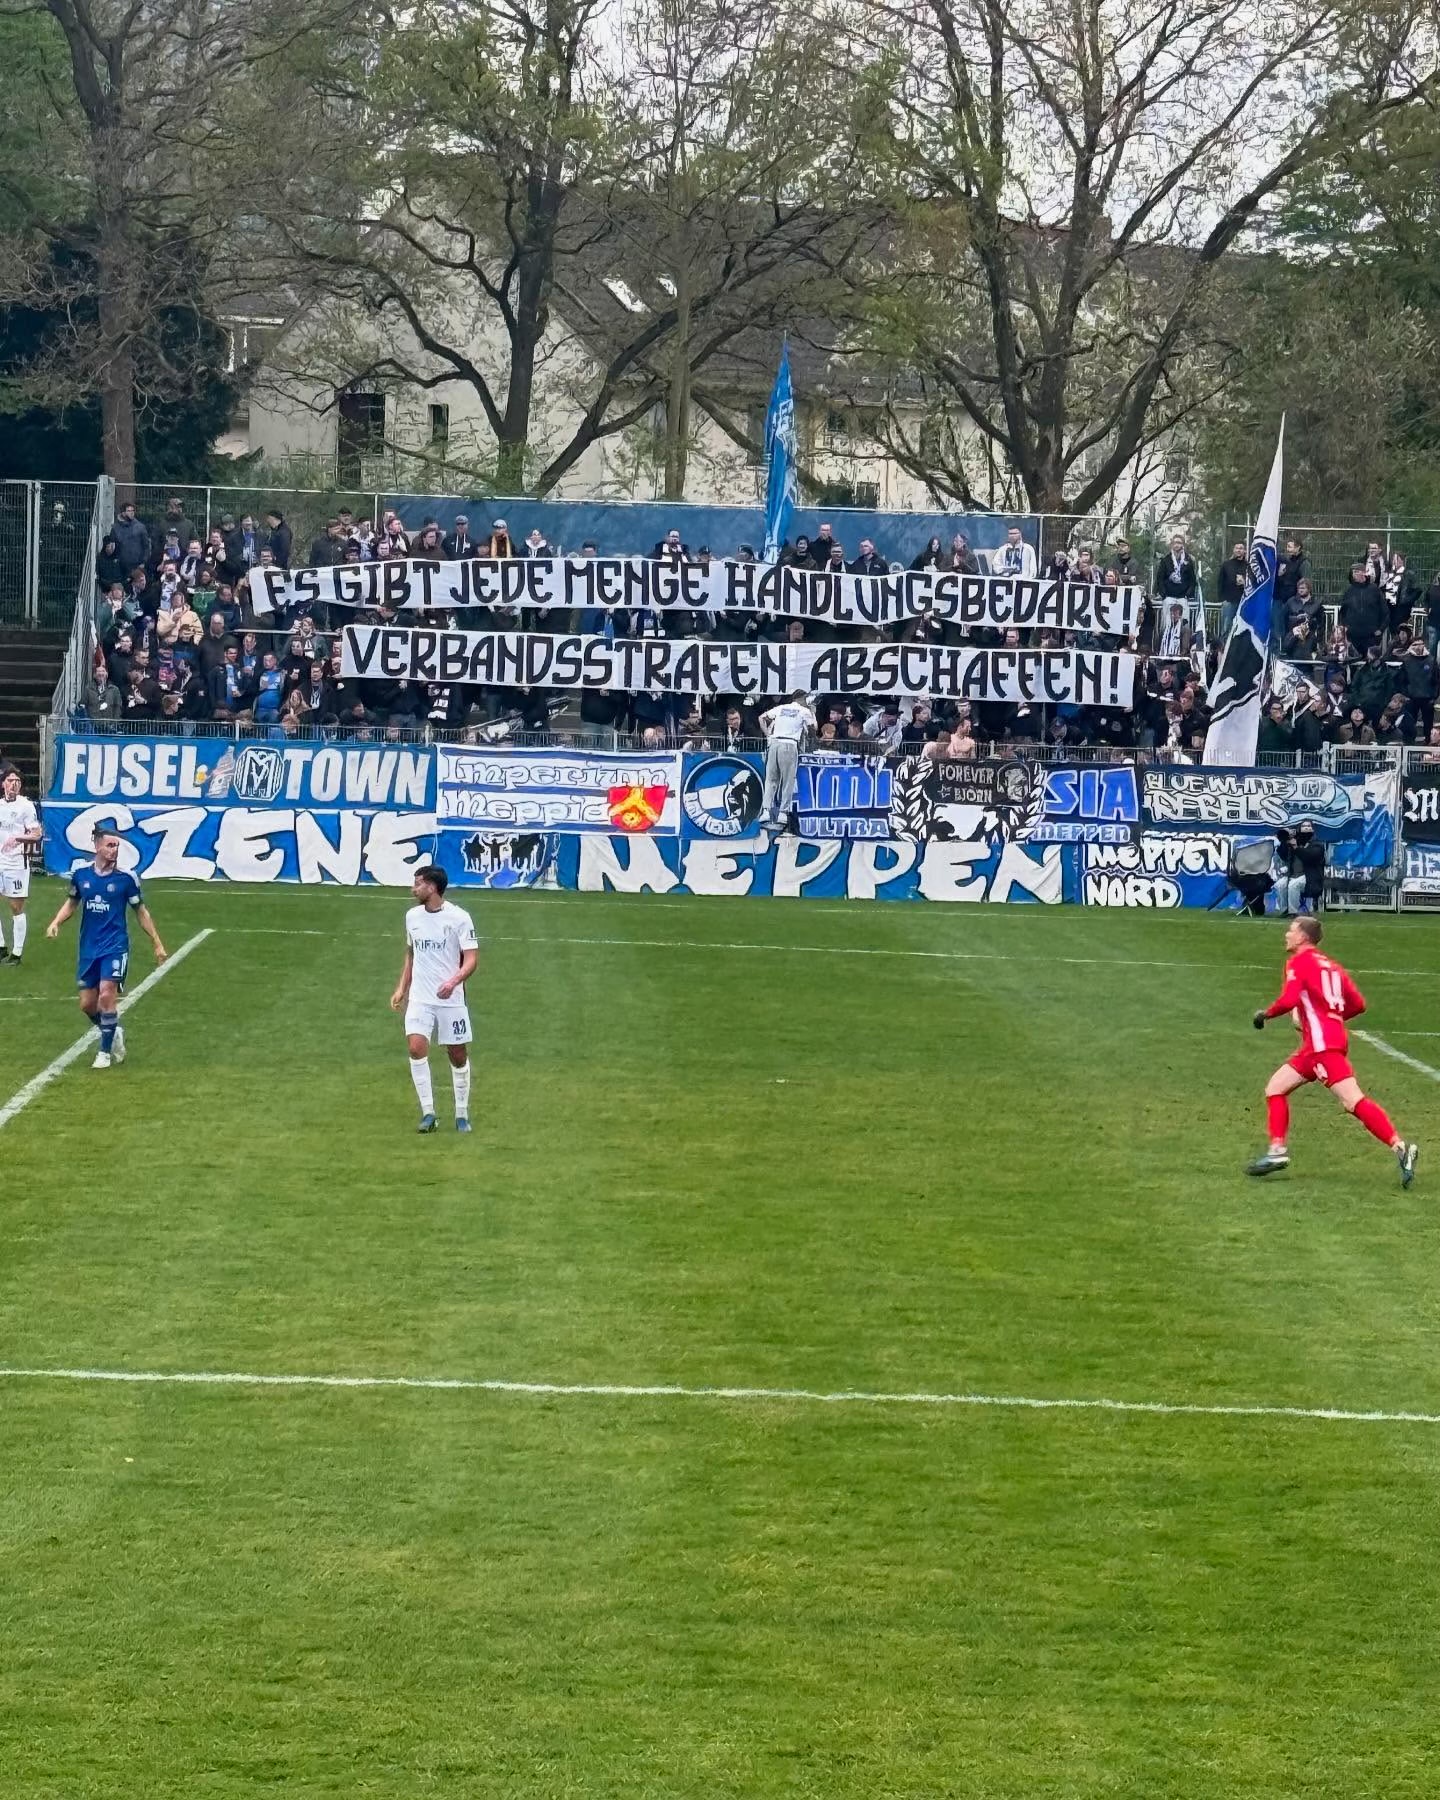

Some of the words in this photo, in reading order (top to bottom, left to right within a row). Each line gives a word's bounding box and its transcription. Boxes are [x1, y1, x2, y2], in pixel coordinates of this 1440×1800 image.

[264, 569, 320, 612] ES
[333, 561, 440, 607] GIBT
[450, 560, 553, 604] JEDE
[565, 560, 709, 606] MENGE
[725, 561, 1132, 634] HANDLUNGSBEDARF!
[346, 627, 787, 692] VERBANDSSTRAFEN
[810, 645, 1119, 704] ABSCHAFFEN!
[62, 742, 202, 798] FUSEL
[283, 748, 431, 806] TOWN
[938, 763, 995, 785] FOREVER
[1145, 772, 1204, 792] BLUE
[1207, 774, 1290, 795] WHITE
[953, 786, 993, 804] BJÖRN
[1149, 791, 1290, 825] REBELS
[798, 816, 890, 838] ULTRA
[65, 803, 443, 887] SZENE
[577, 834, 1064, 904] MEPPEN
[1086, 837, 1230, 873] MEPPEN
[1086, 874, 1178, 907] NORD
